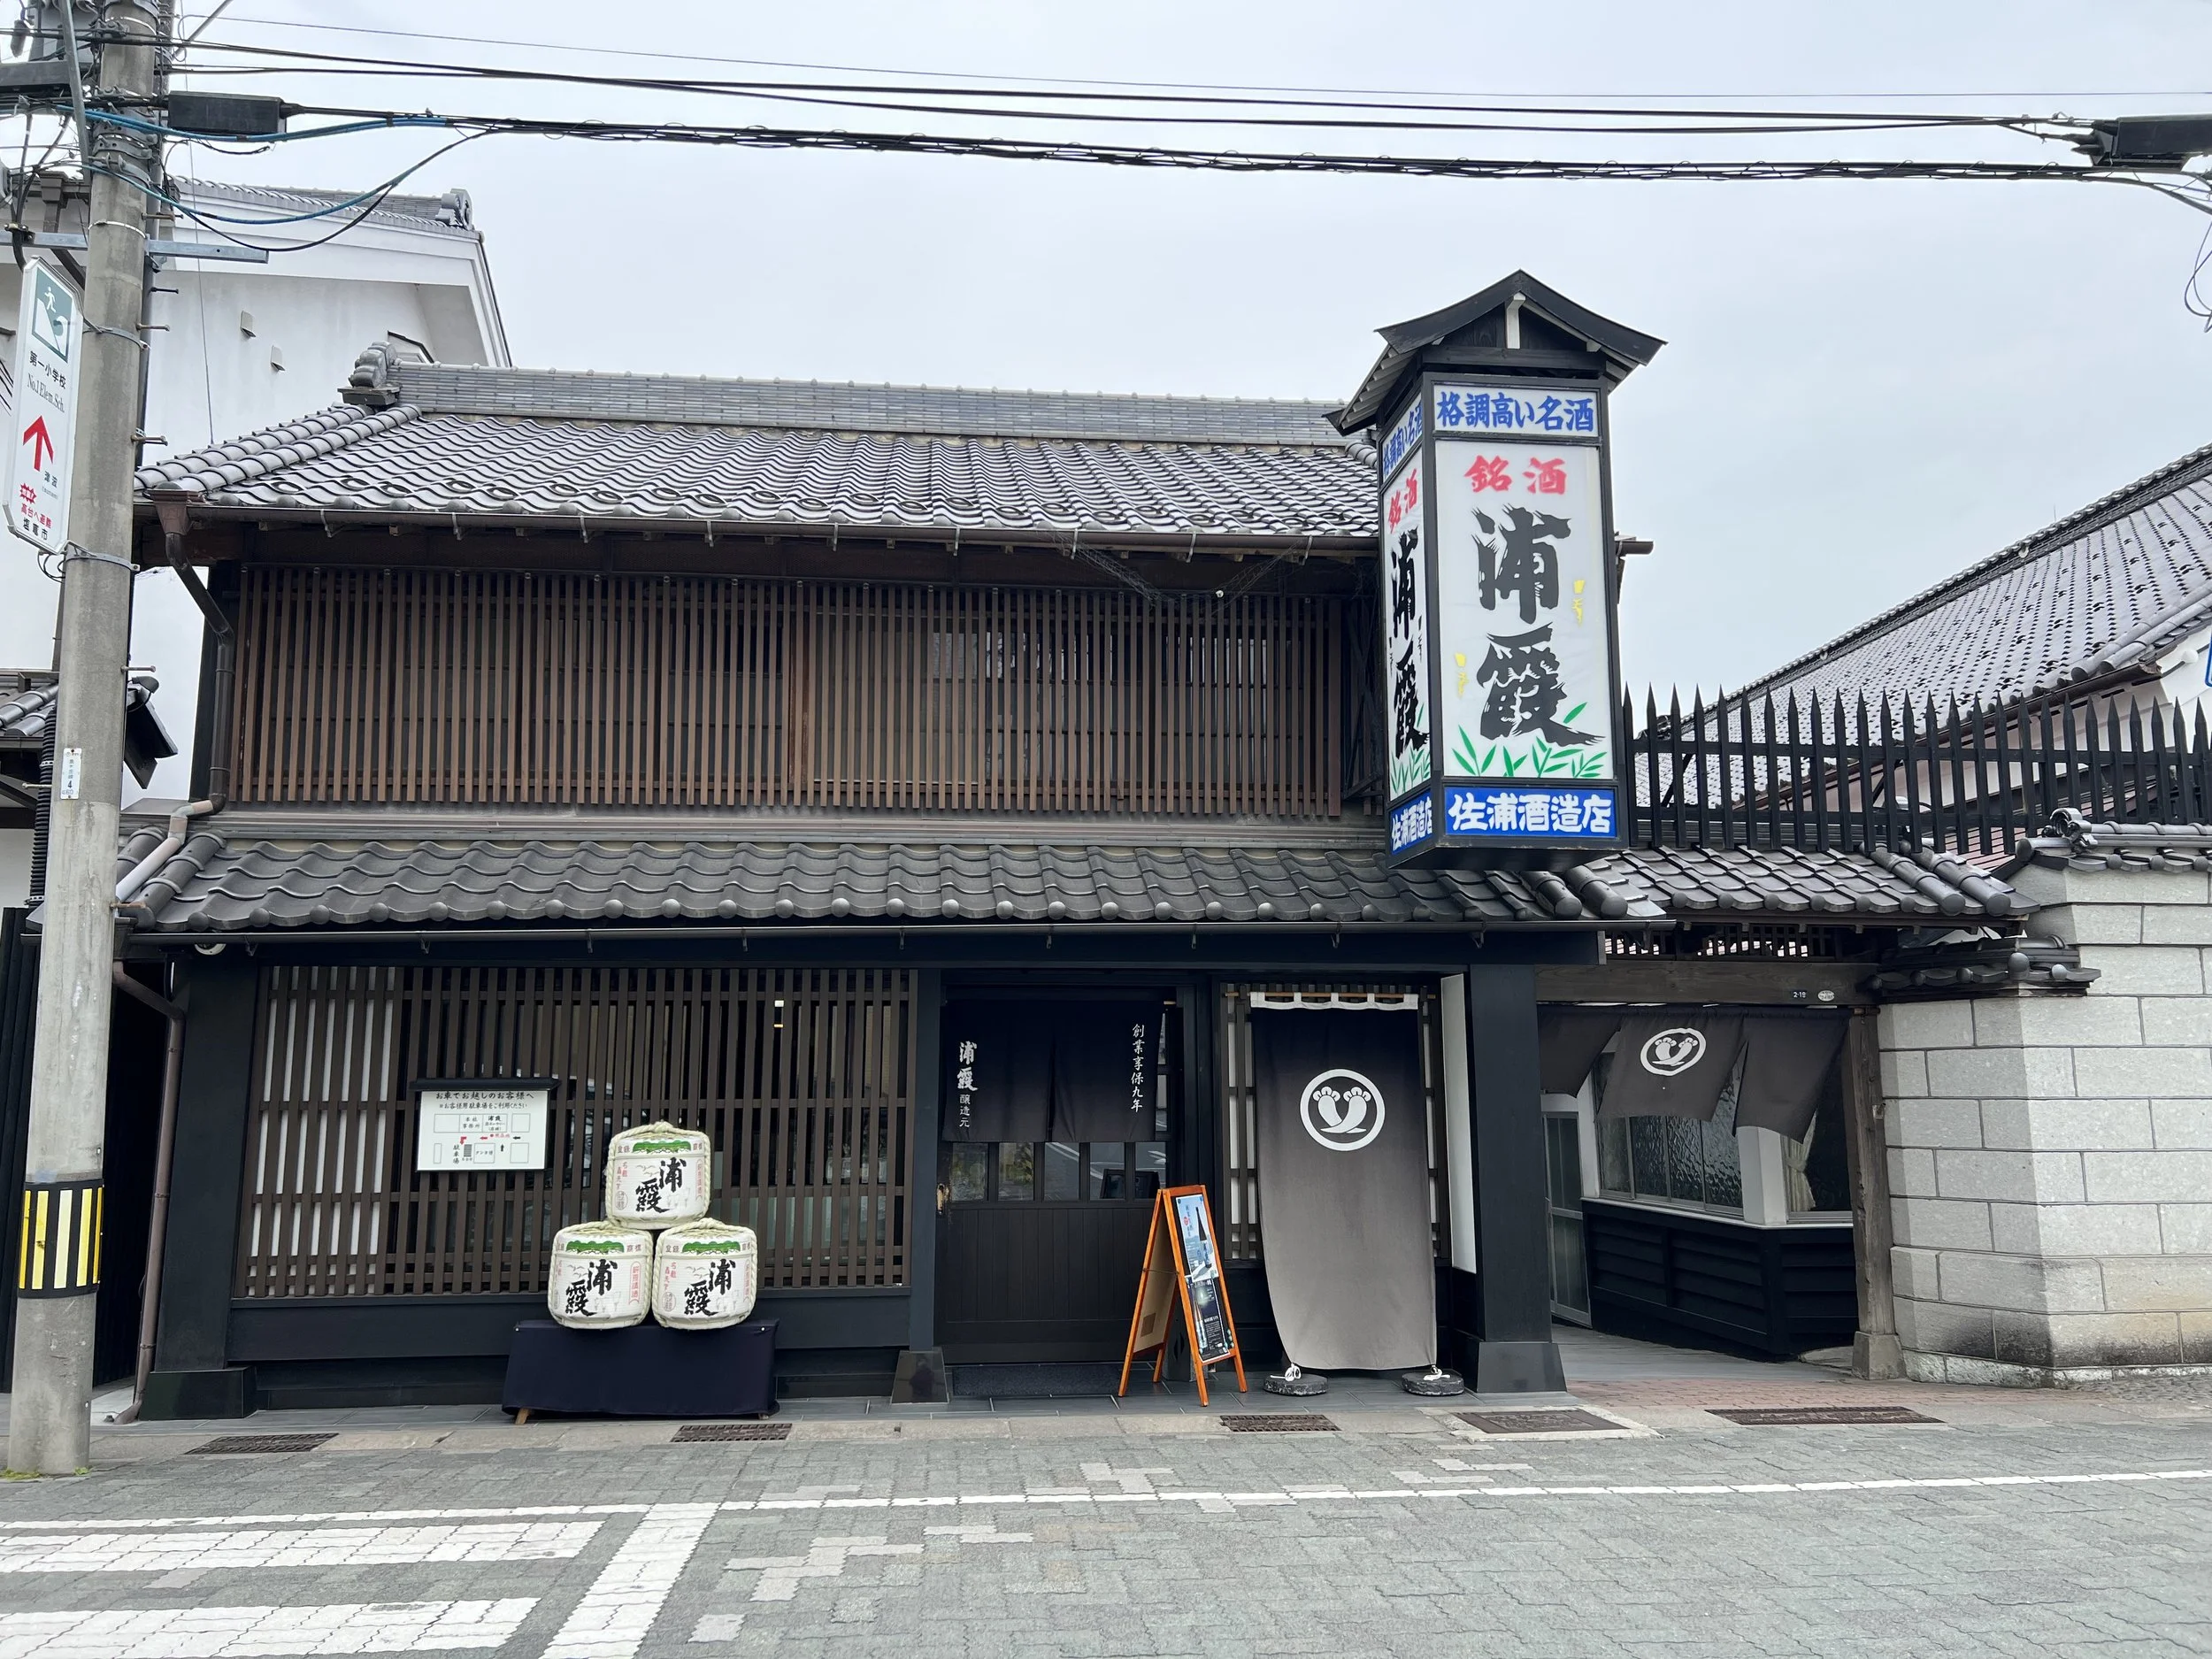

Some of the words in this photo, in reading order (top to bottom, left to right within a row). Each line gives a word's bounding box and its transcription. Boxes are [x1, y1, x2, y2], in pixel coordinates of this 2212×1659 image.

[29, 350, 66, 389] 第一小学校
[1436, 391, 1594, 432] 格調高い名酒
[1464, 455, 1567, 495] 銘酒
[1390, 525, 1431, 760] 浦霞
[1471, 503, 1606, 747] 浦霞
[1448, 792, 1612, 833] 佐浦酒造店
[956, 1041, 979, 1092] 浦霞
[1130, 1023, 1146, 1113] 創業享保九年
[435, 1091, 534, 1100] お車でお越しのお客様へ
[635, 1156, 687, 1213] 浦霞
[565, 1258, 618, 1317] 浦霞
[684, 1258, 736, 1317] 浦霞
